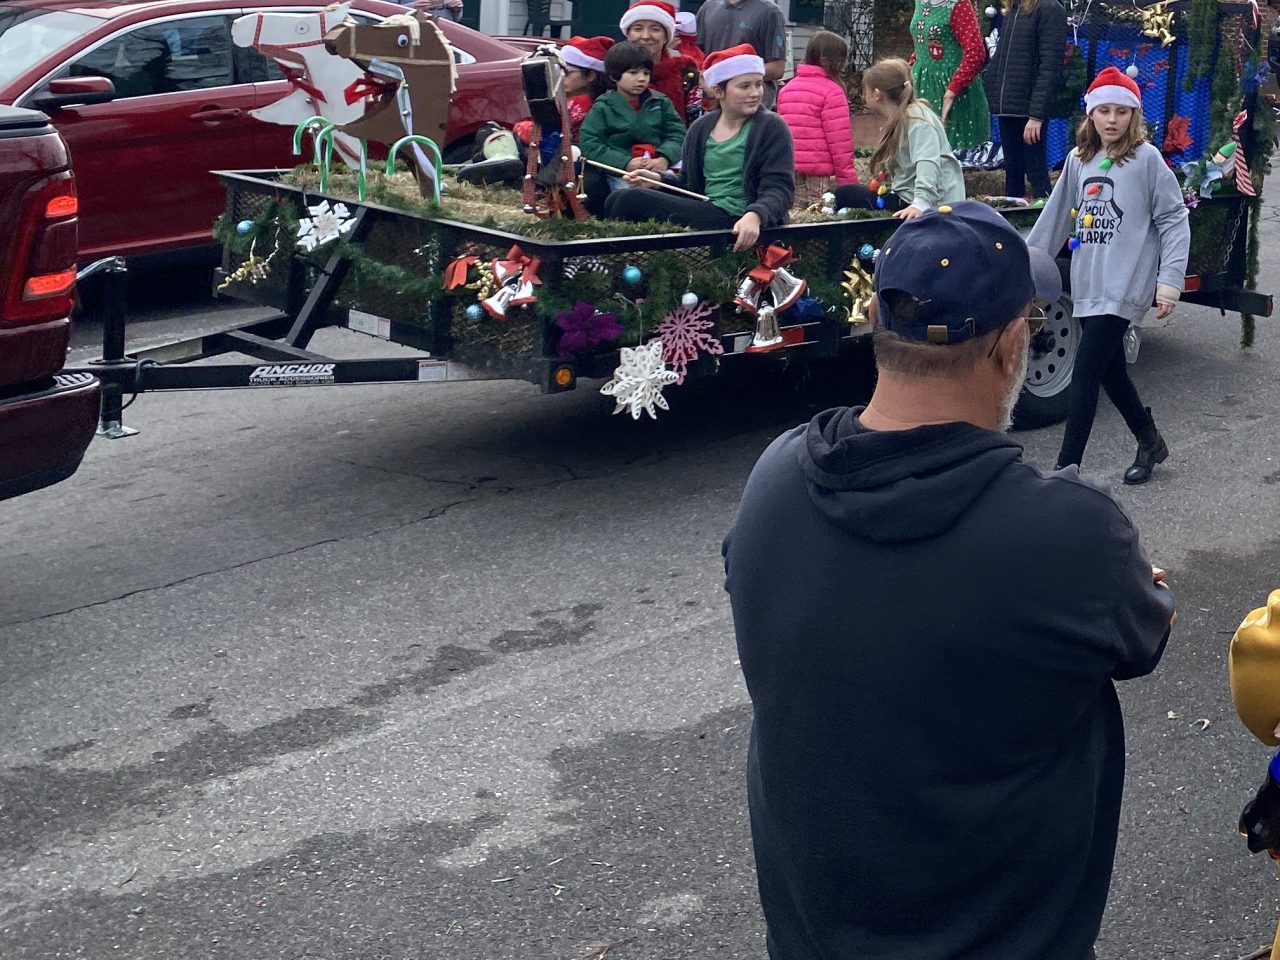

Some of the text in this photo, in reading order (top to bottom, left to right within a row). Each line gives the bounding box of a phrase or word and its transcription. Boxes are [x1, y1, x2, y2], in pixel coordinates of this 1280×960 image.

[1078, 218, 1116, 230] SIOUS
[1080, 230, 1114, 245] LARK?
[249, 363, 336, 378] ANCHOR
